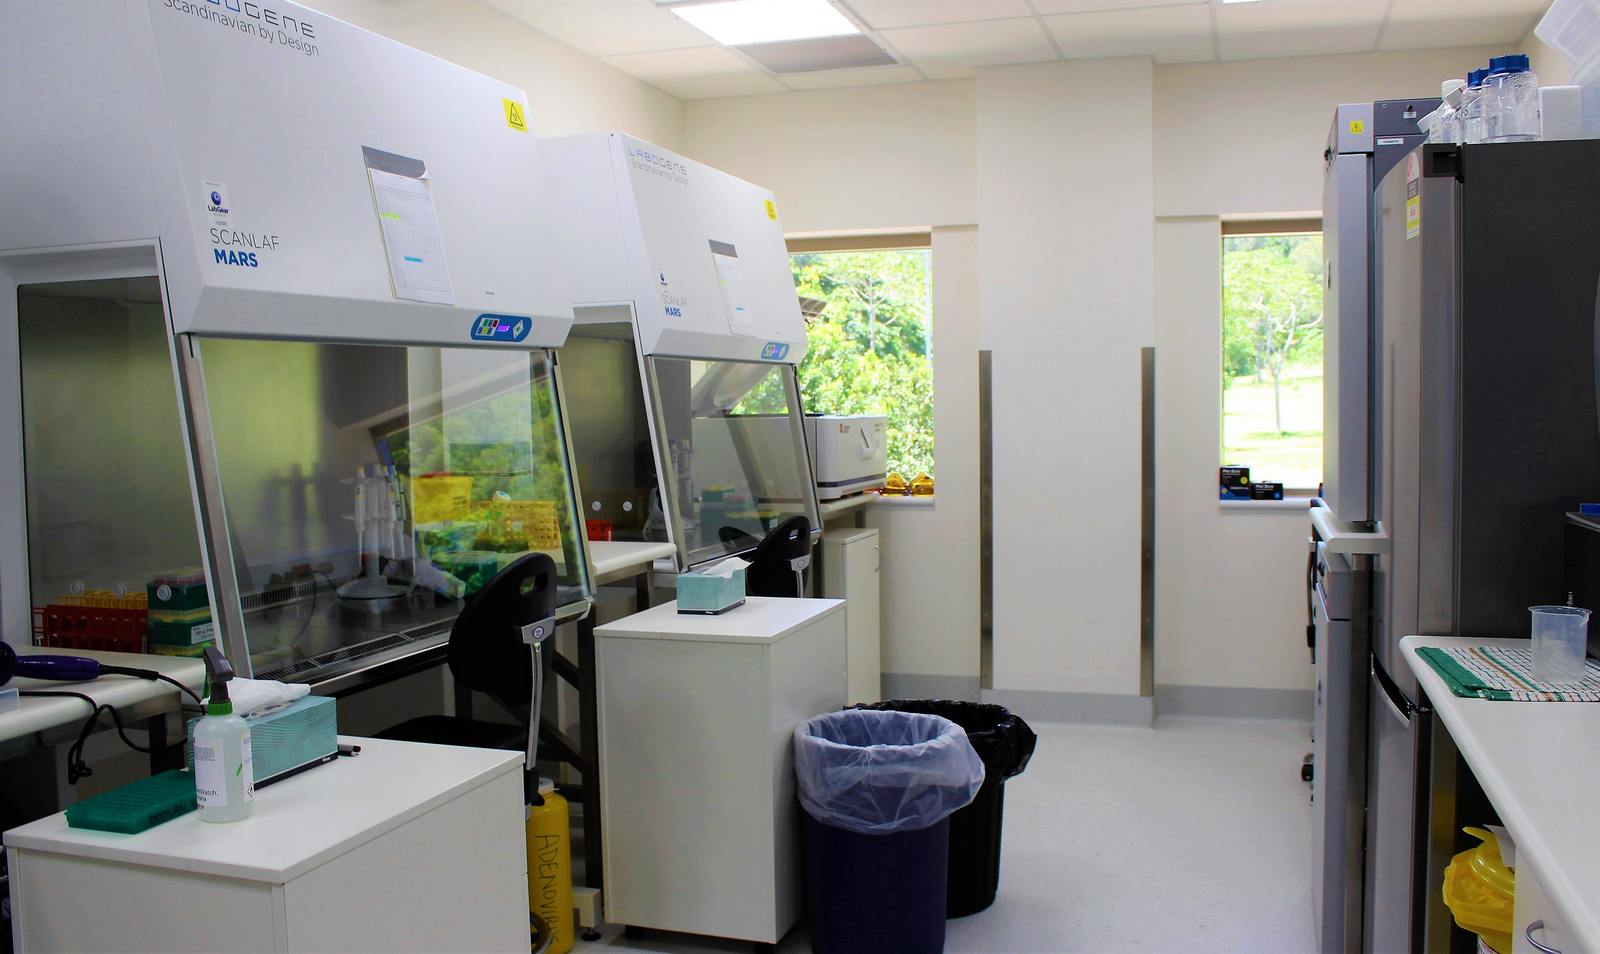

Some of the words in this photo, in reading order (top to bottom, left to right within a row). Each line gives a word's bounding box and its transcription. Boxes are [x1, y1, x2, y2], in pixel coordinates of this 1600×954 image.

[164, 0, 256, 36] Scandinavian
[259, 26, 274, 44] by
[278, 31, 320, 56] Design
[207, 0, 316, 39] OGENE
[207, 205, 229, 214] LabGear
[210, 227, 279, 250] SCANLAF
[214, 248, 258, 268] MARS
[664, 306, 682, 317] MARS
